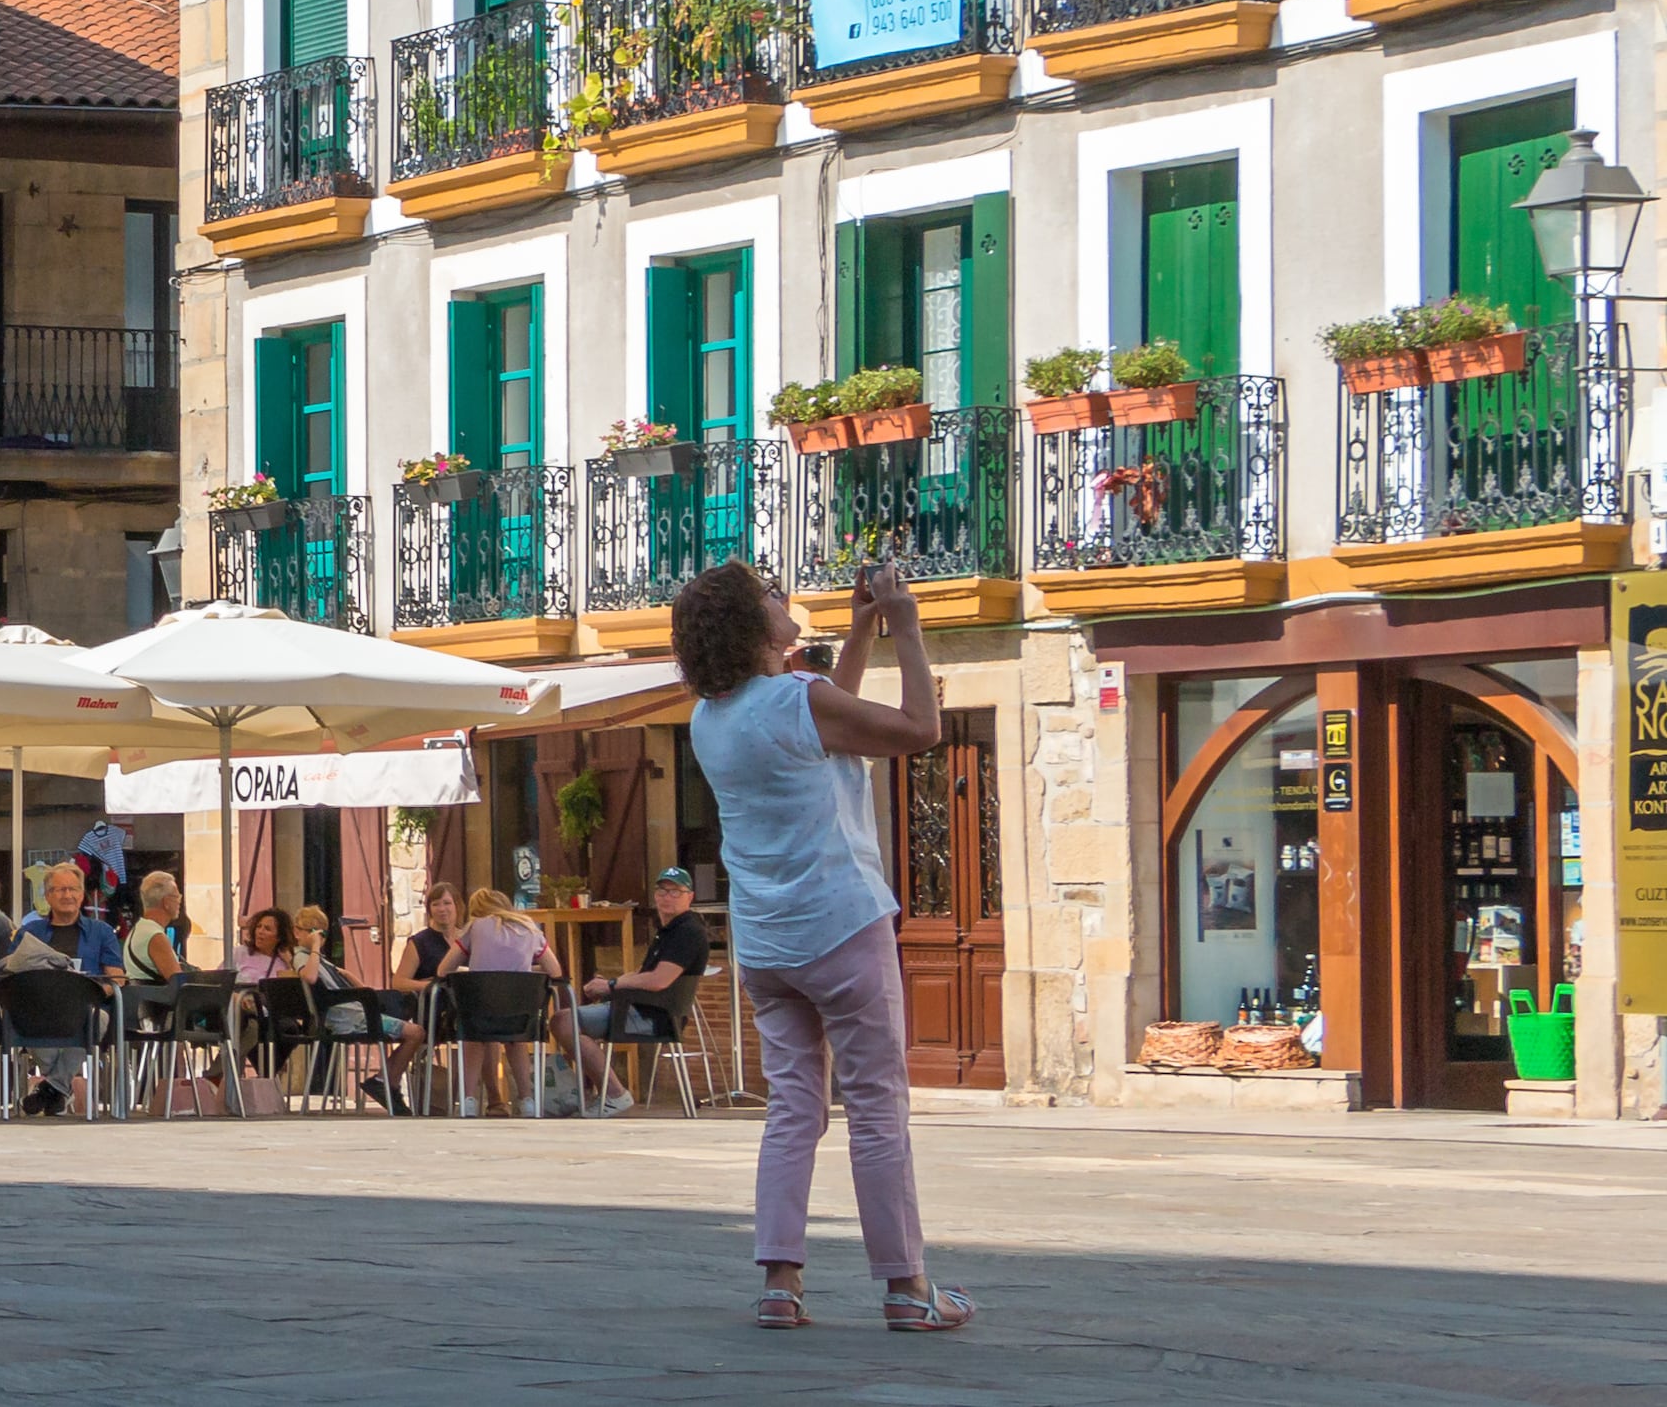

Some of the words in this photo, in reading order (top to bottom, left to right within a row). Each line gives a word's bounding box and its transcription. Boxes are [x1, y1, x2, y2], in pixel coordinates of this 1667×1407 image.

[872, 12, 895, 35] 943
[900, 6, 924, 29] 640
[500, 686, 529, 700] Mah
[1647, 781, 1667, 795] AR
[1634, 800, 1667, 814] KON
[1635, 887, 1667, 901] GUZ
